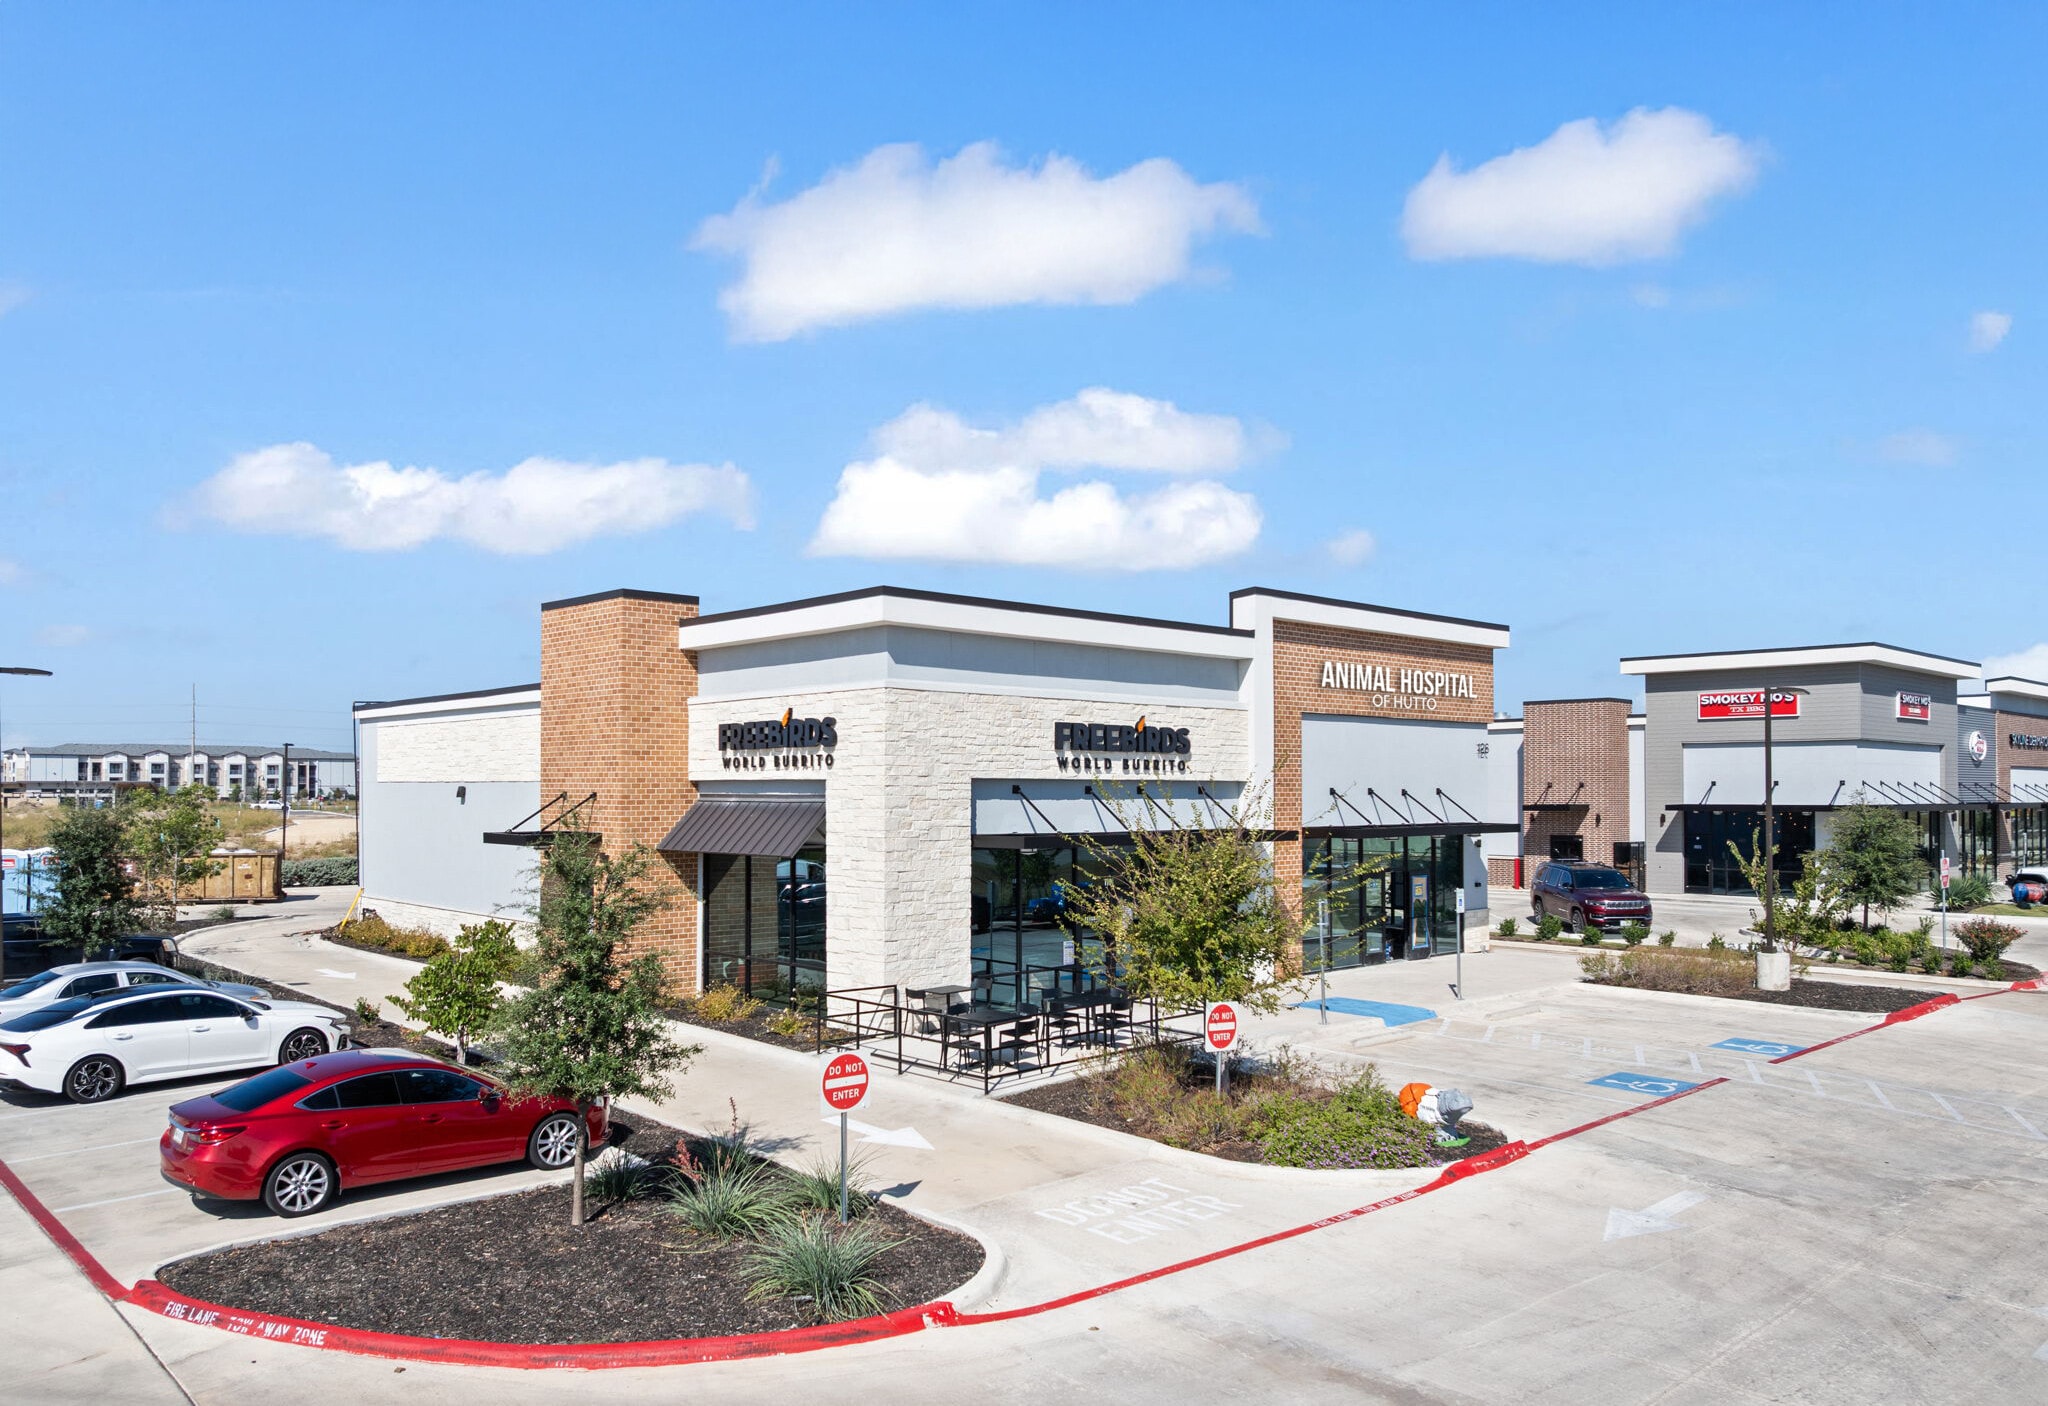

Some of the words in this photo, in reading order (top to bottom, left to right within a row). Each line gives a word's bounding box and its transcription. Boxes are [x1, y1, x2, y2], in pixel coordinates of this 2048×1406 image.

[1322, 661, 1395, 692] ANIMAL
[1401, 668, 1478, 699] HOSPITAL
[1372, 694, 1391, 708] OF
[1394, 695, 1437, 711] HUTTO
[1701, 694, 1757, 705] SMOKEY
[722, 756, 766, 769] WORLD
[774, 753, 834, 768] BURRITO
[1057, 757, 1112, 770] WORLD
[1122, 758, 1186, 772] BURRITO
[1211, 1012, 1220, 1021] DO
[1222, 1011, 1233, 1020] NOT
[1213, 1033, 1231, 1042] ENTER
[829, 1065, 841, 1076] DO
[845, 1062, 862, 1074] NOT
[832, 1088, 860, 1101] ENTER
[1034, 1200, 1114, 1227] DO
[1092, 1178, 1190, 1209] NOT
[1087, 1195, 1244, 1244] ENTER
[165, 1301, 188, 1320] FIRE
[188, 1306, 220, 1327] LANE
[292, 1326, 329, 1346] ZONE
